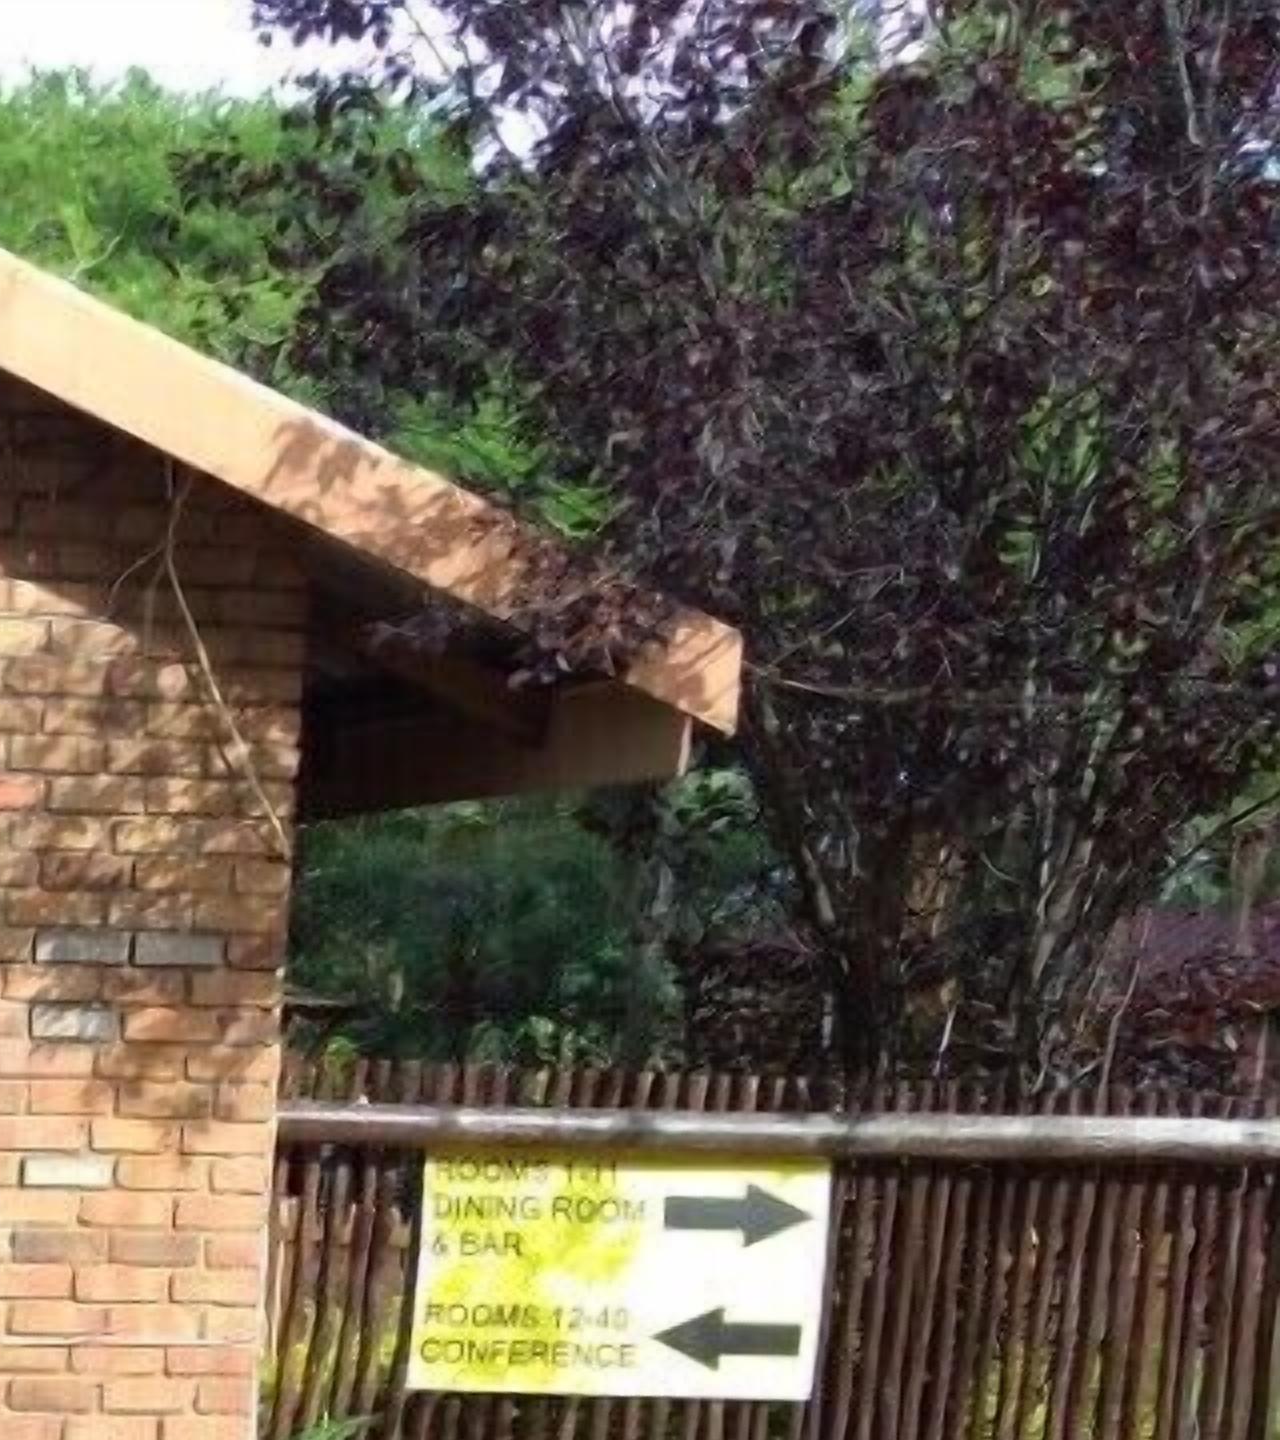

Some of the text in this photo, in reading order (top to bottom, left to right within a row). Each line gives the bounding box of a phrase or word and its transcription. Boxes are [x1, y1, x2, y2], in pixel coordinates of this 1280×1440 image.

[433, 1157, 550, 1184] ROOMS
[432, 1192, 646, 1224] DINING ROOM
[431, 1231, 524, 1258] & BAR
[423, 1302, 631, 1332] ROOMS 12-40
[420, 1336, 637, 1369] CONFERENCE
